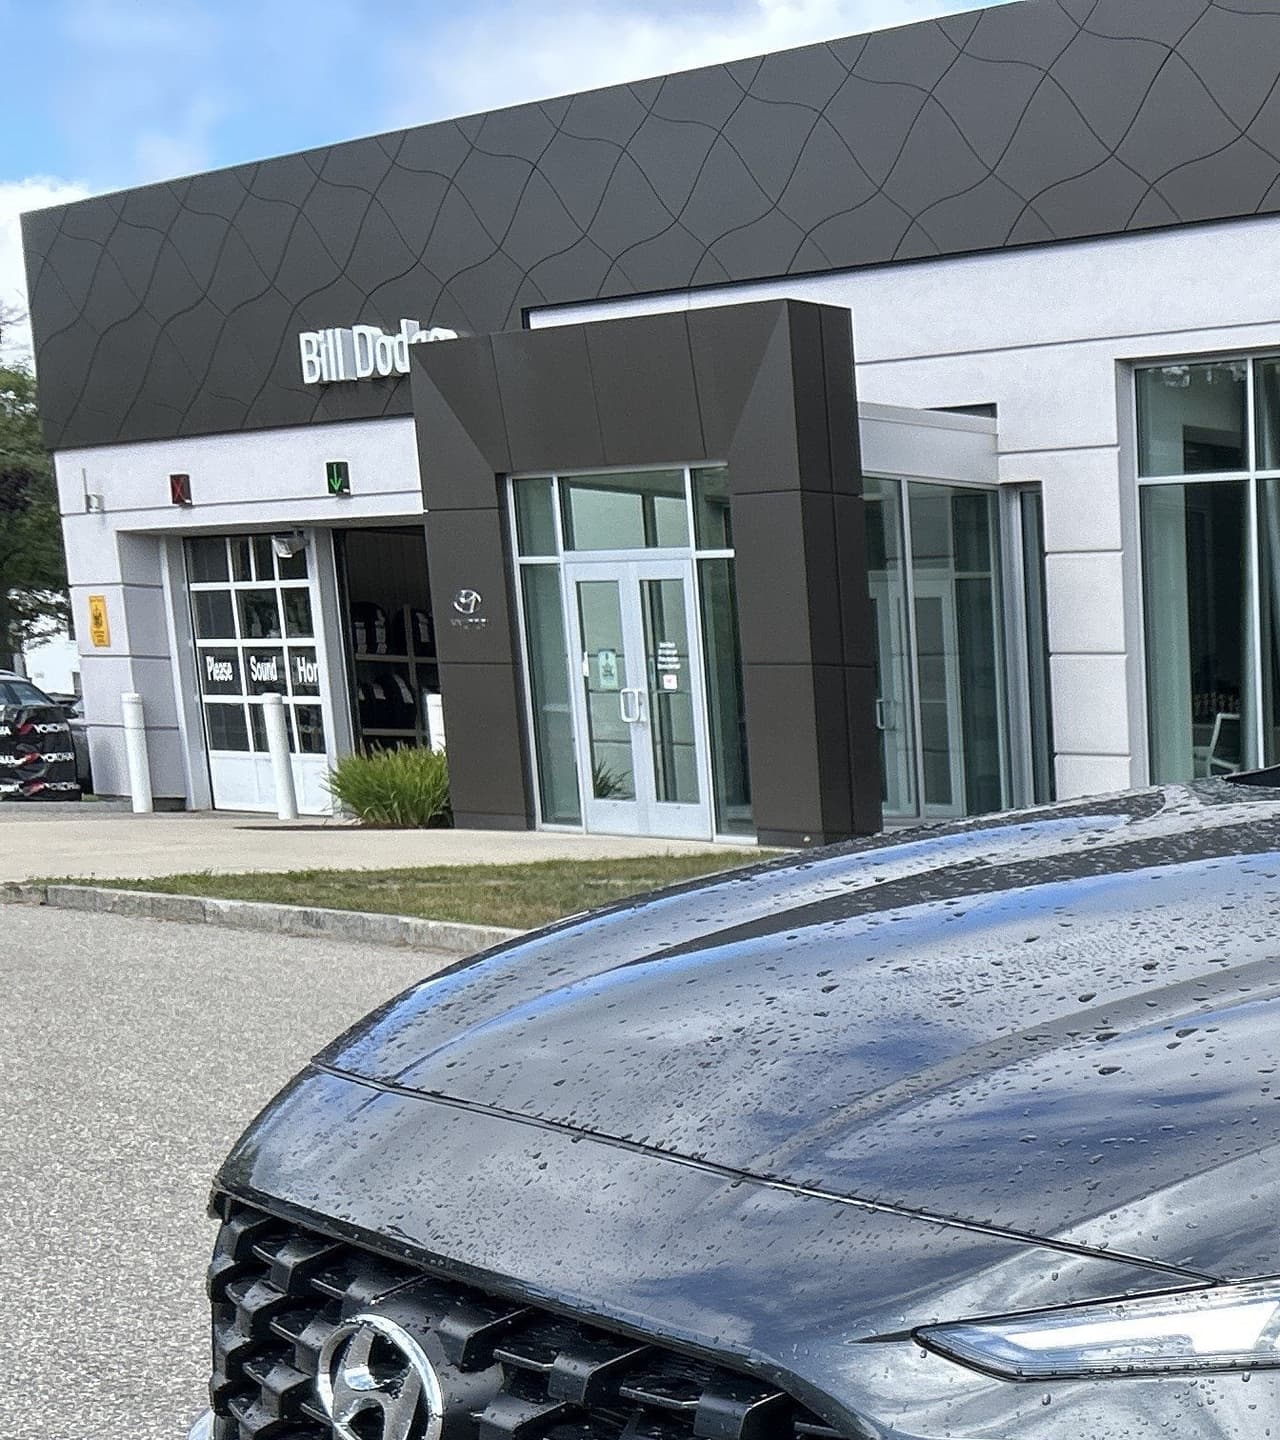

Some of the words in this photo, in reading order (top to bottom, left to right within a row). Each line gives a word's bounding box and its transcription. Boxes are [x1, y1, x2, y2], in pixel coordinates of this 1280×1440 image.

[299, 327, 353, 384] Bill
[352, 318, 458, 378] Dod
[205, 655, 234, 682] Please
[250, 655, 278, 682] Sound
[296, 656, 320, 683] Hor
